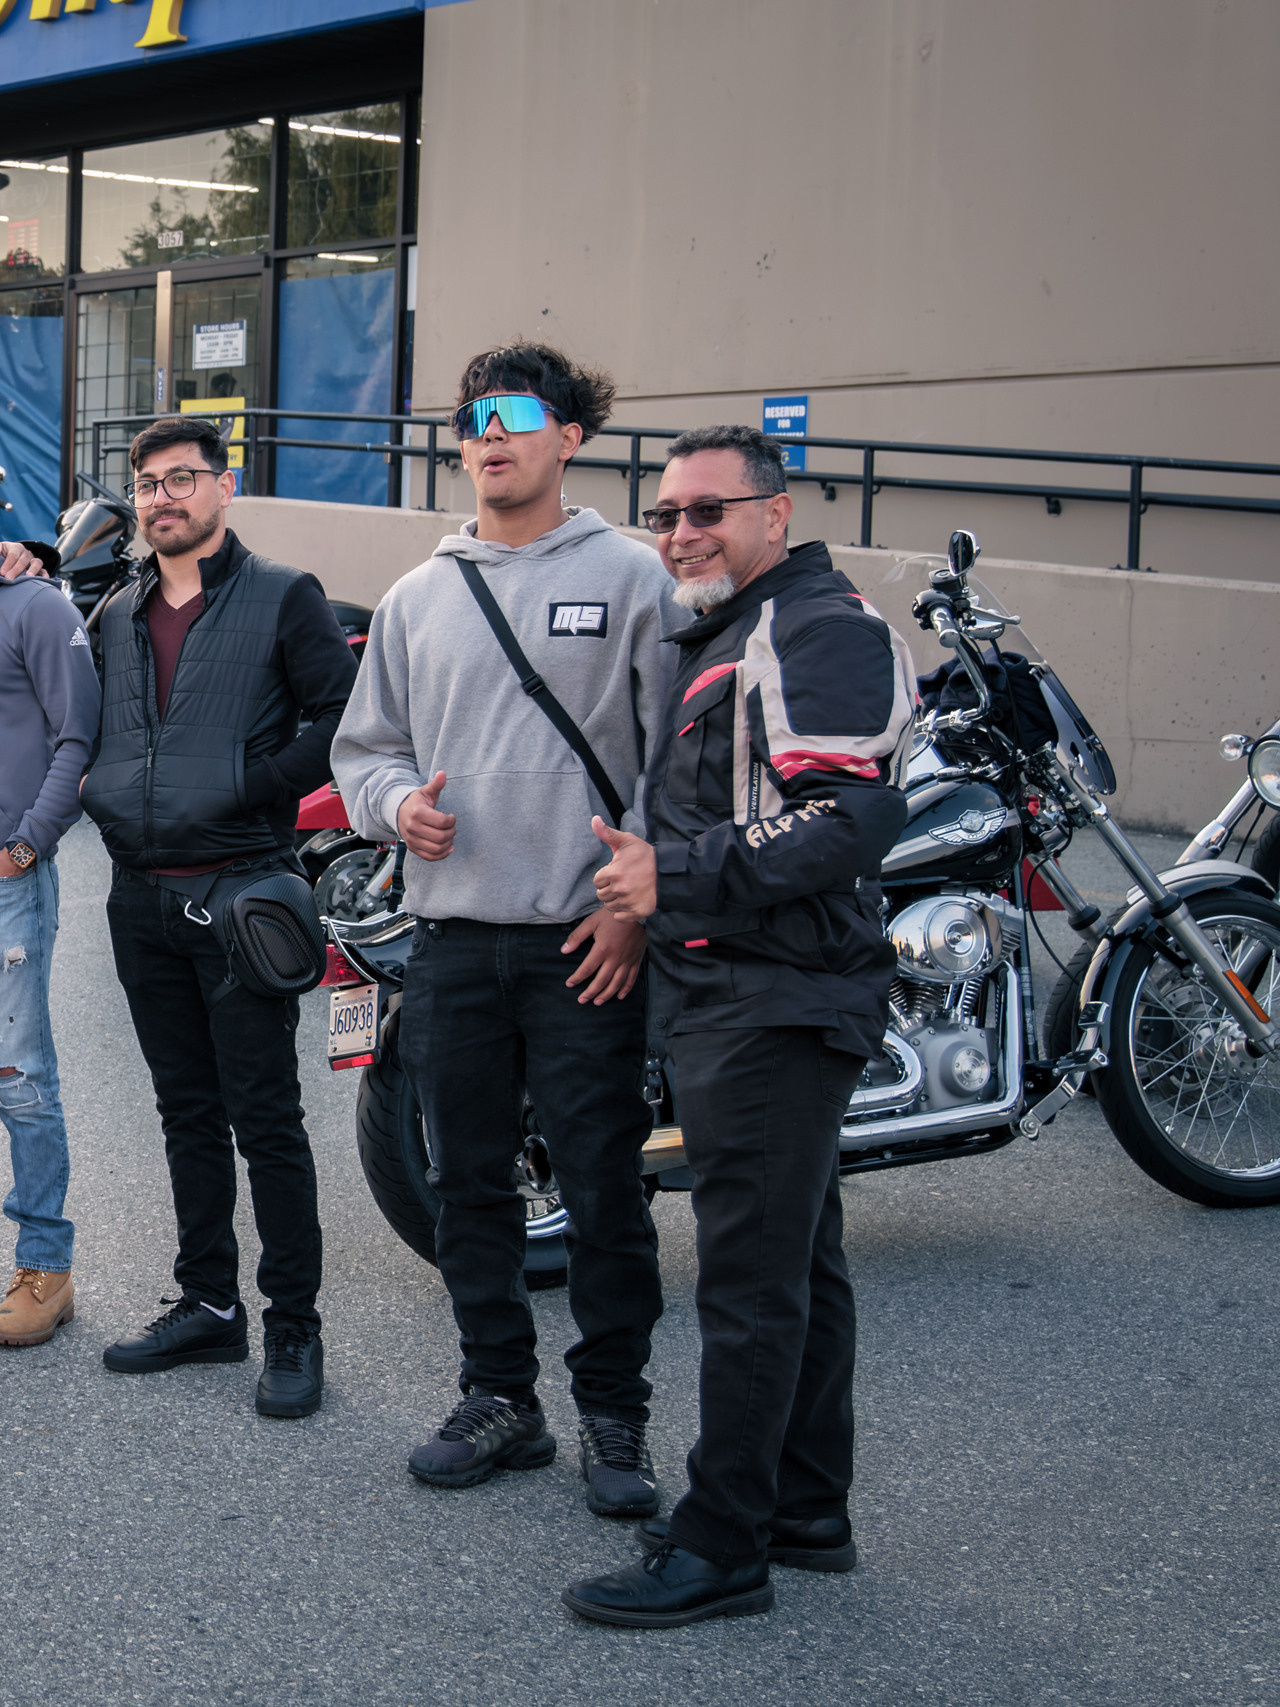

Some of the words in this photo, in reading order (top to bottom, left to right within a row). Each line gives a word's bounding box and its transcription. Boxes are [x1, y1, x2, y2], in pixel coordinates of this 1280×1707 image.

[159, 231, 182, 247] 3057
[200, 325, 219, 333] STORE
[765, 405, 806, 419] RESERVED
[777, 418, 791, 429] FOR
[751, 762, 759, 810] VENTILATION
[330, 1002, 373, 1036] J60938
